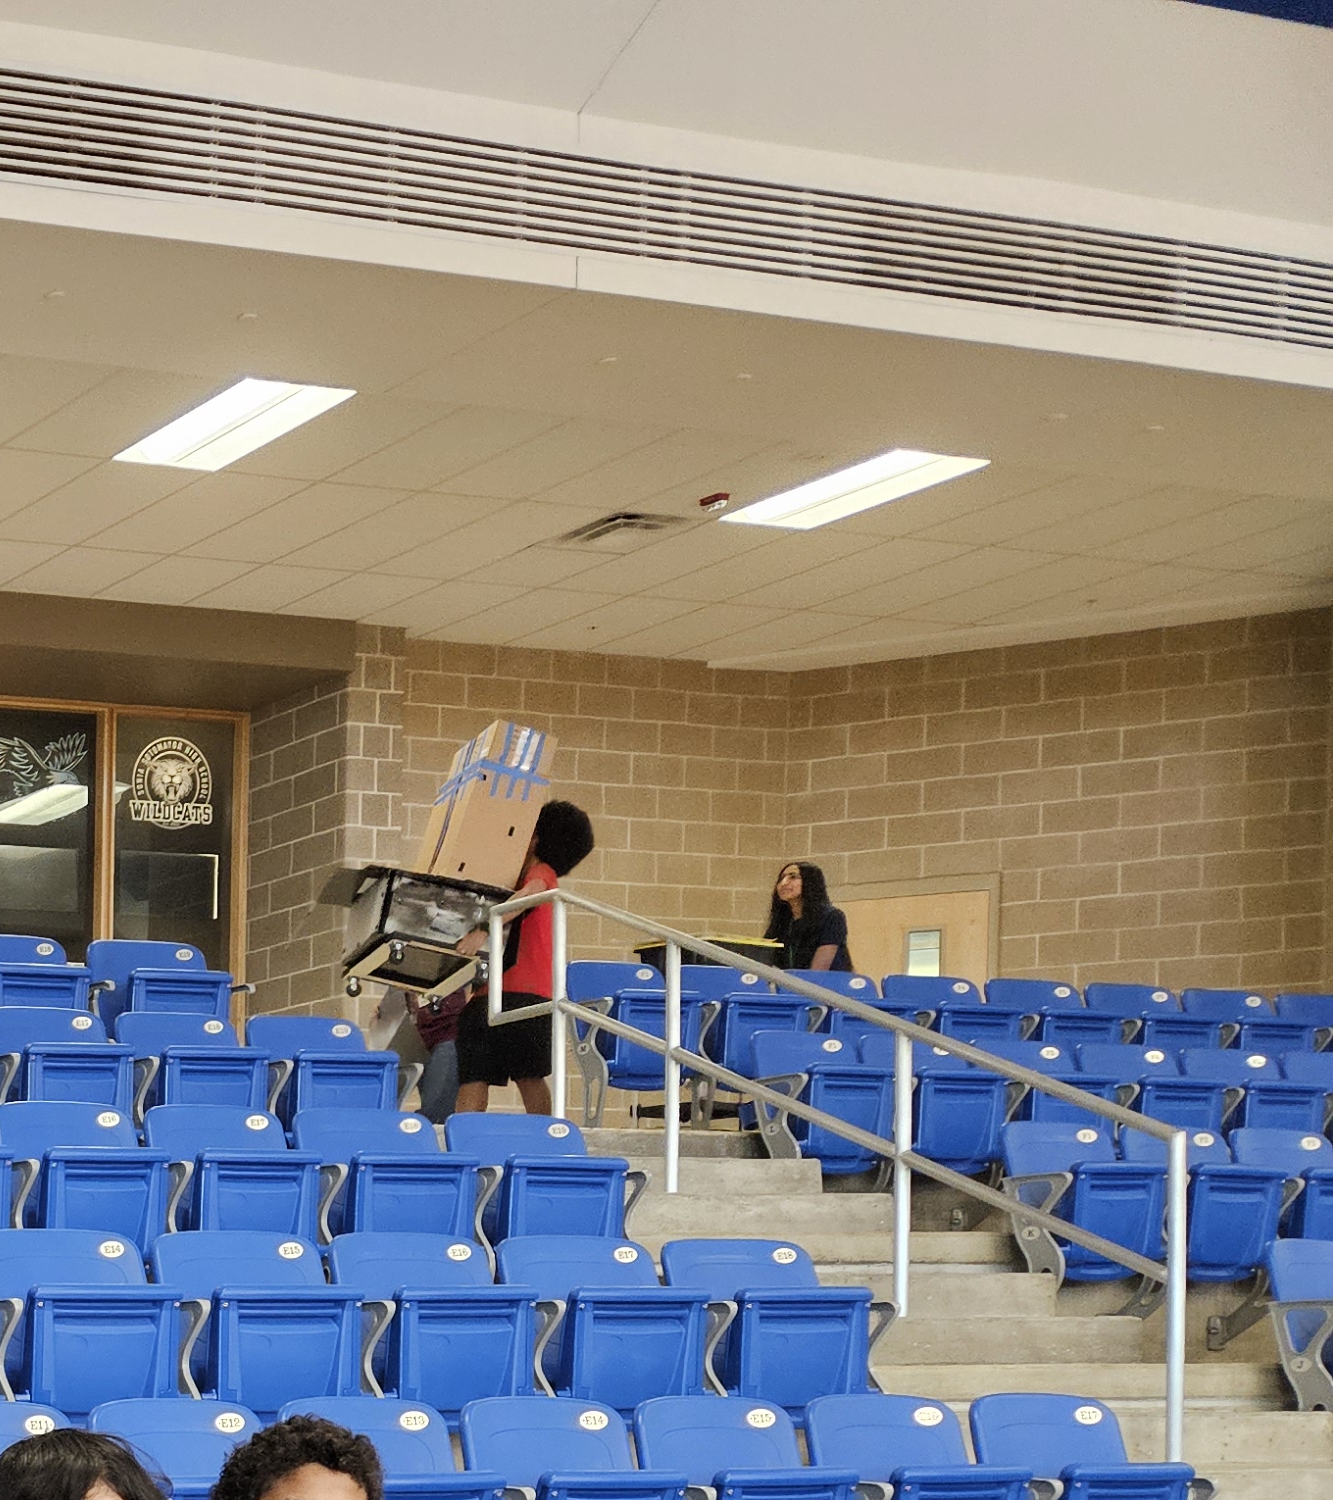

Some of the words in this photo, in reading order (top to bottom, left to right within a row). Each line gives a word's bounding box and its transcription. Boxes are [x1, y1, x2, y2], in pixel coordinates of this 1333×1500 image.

[129, 800, 213, 825] WILDCATS
[104, 1245, 121, 1253] E14
[282, 1246, 300, 1255] E15
[451, 1248, 469, 1257] E16
[617, 1250, 634, 1259] E17
[776, 1251, 794, 1260] E18
[752, 1413, 771, 1423] E15
[1080, 1410, 1098, 1420] E17
[30, 1420, 49, 1431] E11
[221, 1418, 241, 1428] E12
[405, 1415, 425, 1426] E13
[584, 1416, 604, 1426] E14
